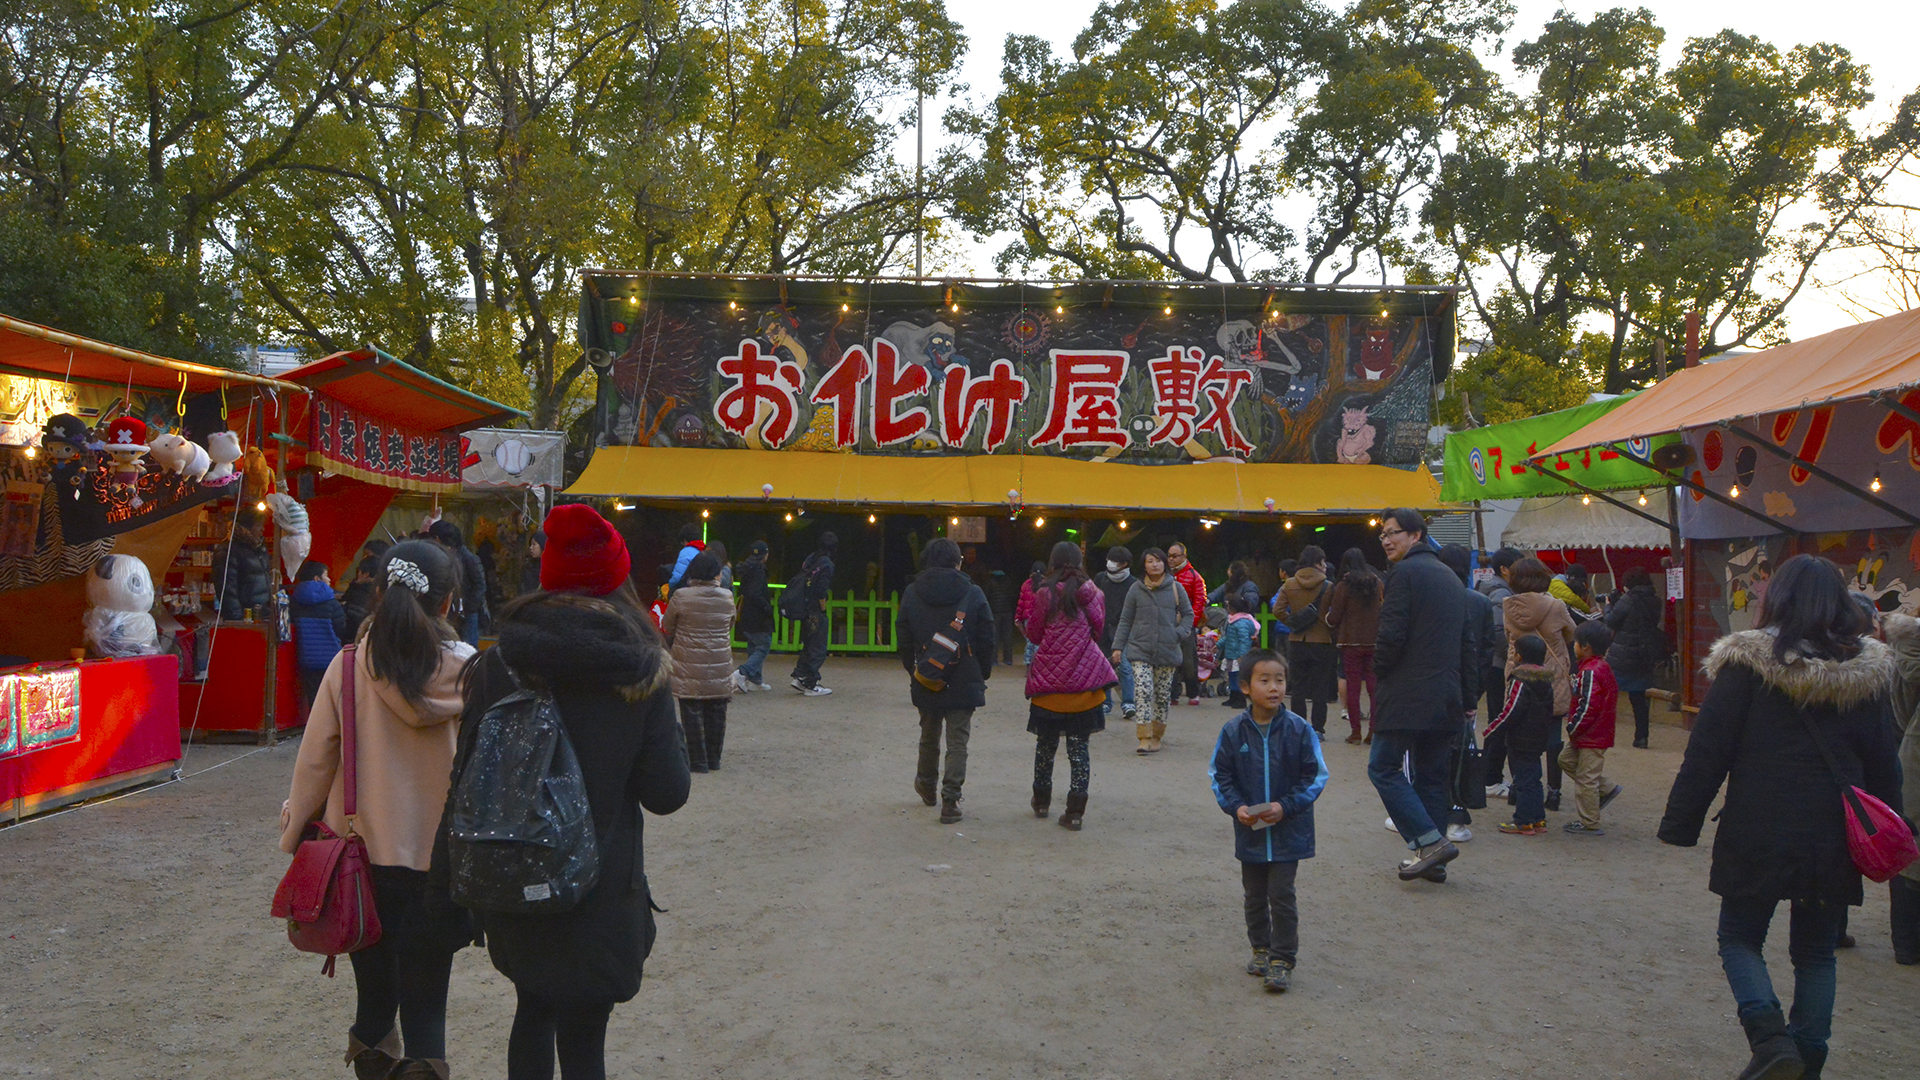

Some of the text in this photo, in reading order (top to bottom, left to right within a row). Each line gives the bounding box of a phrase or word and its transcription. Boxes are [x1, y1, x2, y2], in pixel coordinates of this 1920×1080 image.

[714, 338, 1256, 455] お化け屋敷
